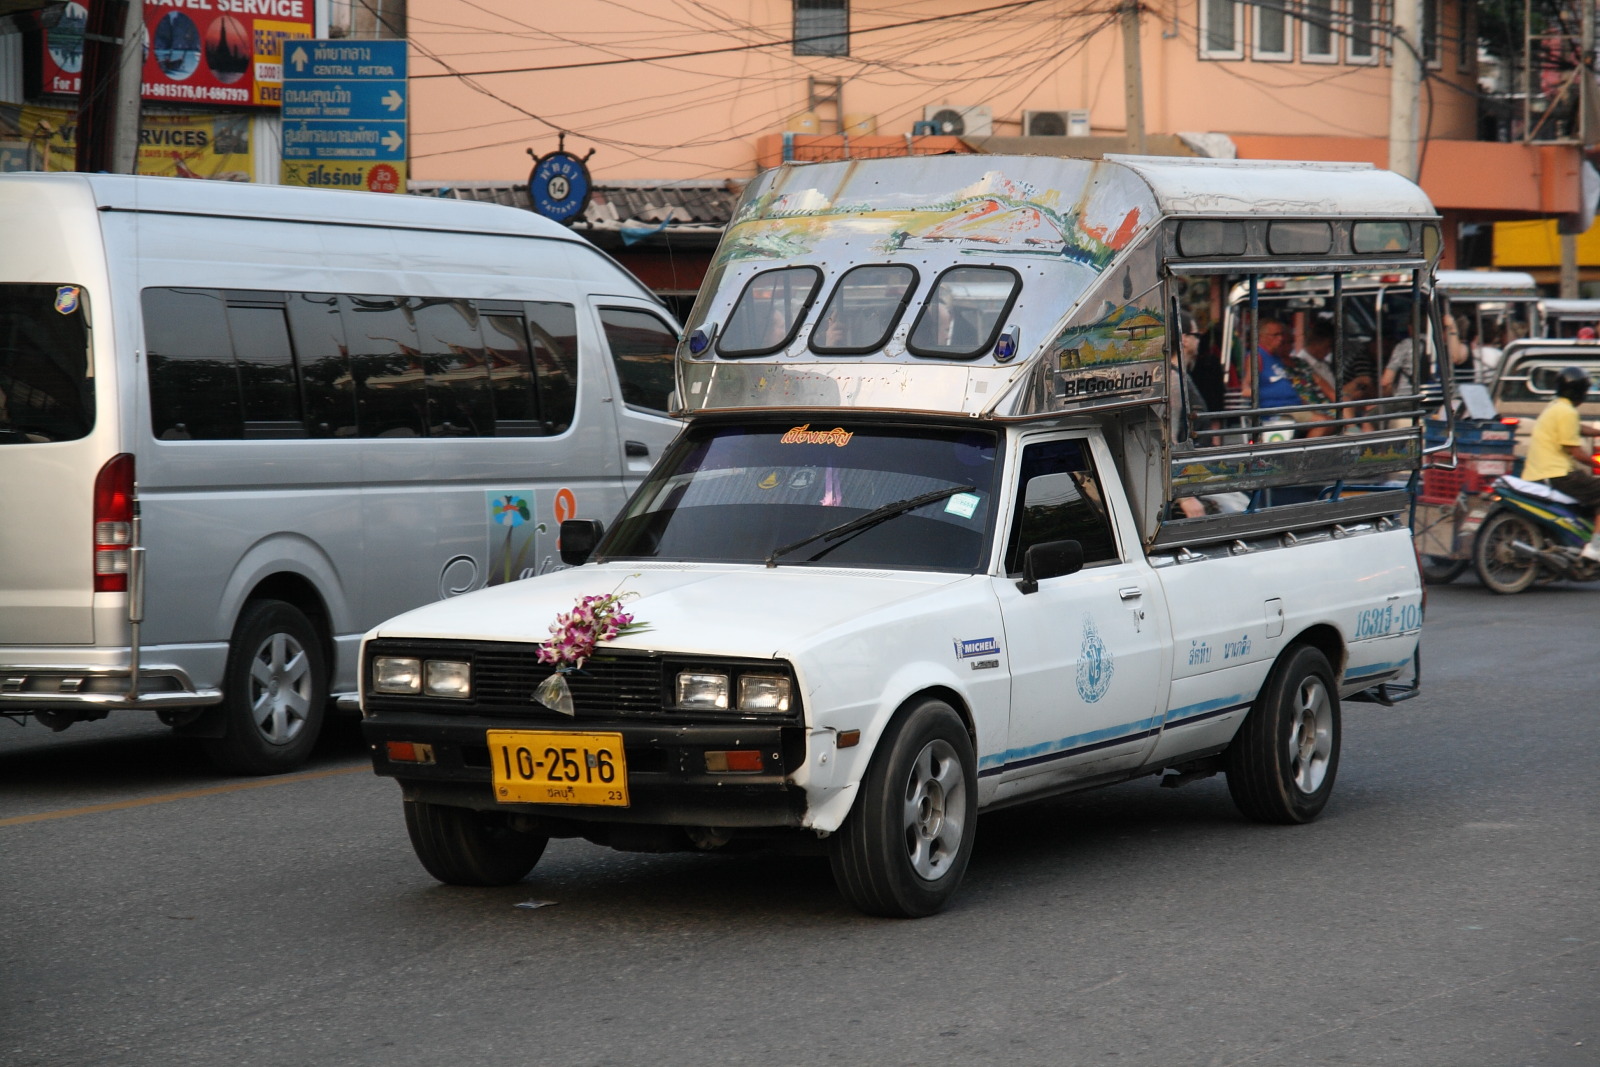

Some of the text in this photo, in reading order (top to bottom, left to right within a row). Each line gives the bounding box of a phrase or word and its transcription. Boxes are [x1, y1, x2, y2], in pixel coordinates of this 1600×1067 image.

[217, 0, 304, 18] SERVICE
[314, 42, 371, 61] พัทยากลาง
[313, 65, 394, 75] CENTRAL PATTAYA
[140, 129, 209, 146] RVICES
[551, 182, 565, 195] 14
[541, 200, 577, 213] PATTAYA
[1064, 371, 1153, 398] BFGoodrich
[502, 745, 615, 784] 10-2516
[547, 786, 576, 801] ชลบุรี
[608, 791, 623, 801] 23
